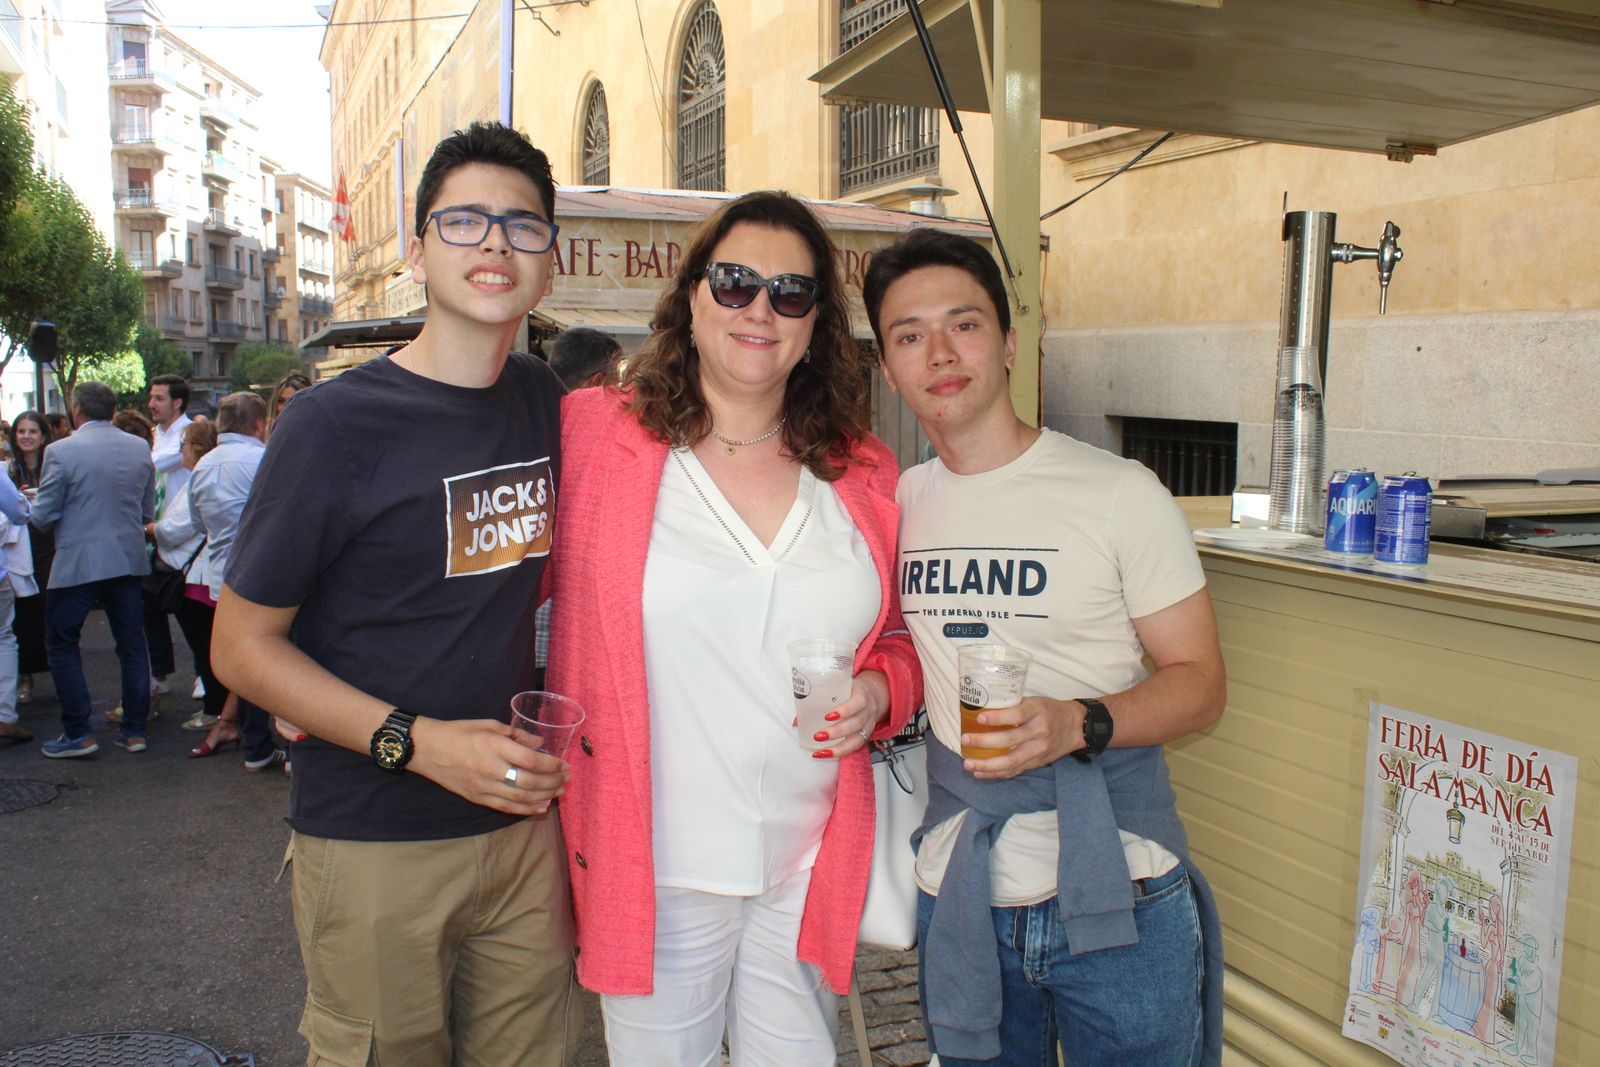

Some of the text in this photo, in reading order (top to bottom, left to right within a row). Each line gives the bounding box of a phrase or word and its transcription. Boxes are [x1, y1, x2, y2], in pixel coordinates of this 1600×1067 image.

[465, 511, 547, 556] JONES
[901, 559, 1047, 596] IRELAND
[942, 609, 982, 617] EMERALD
[987, 611, 1009, 619] ISLE
[1381, 716, 1555, 796] FERIA DE DÍA
[1377, 753, 1553, 837] SALAMANCA
[1491, 824, 1504, 836] DEL
[1530, 837, 1539, 848] 15
[1541, 841, 1550, 852] DE
